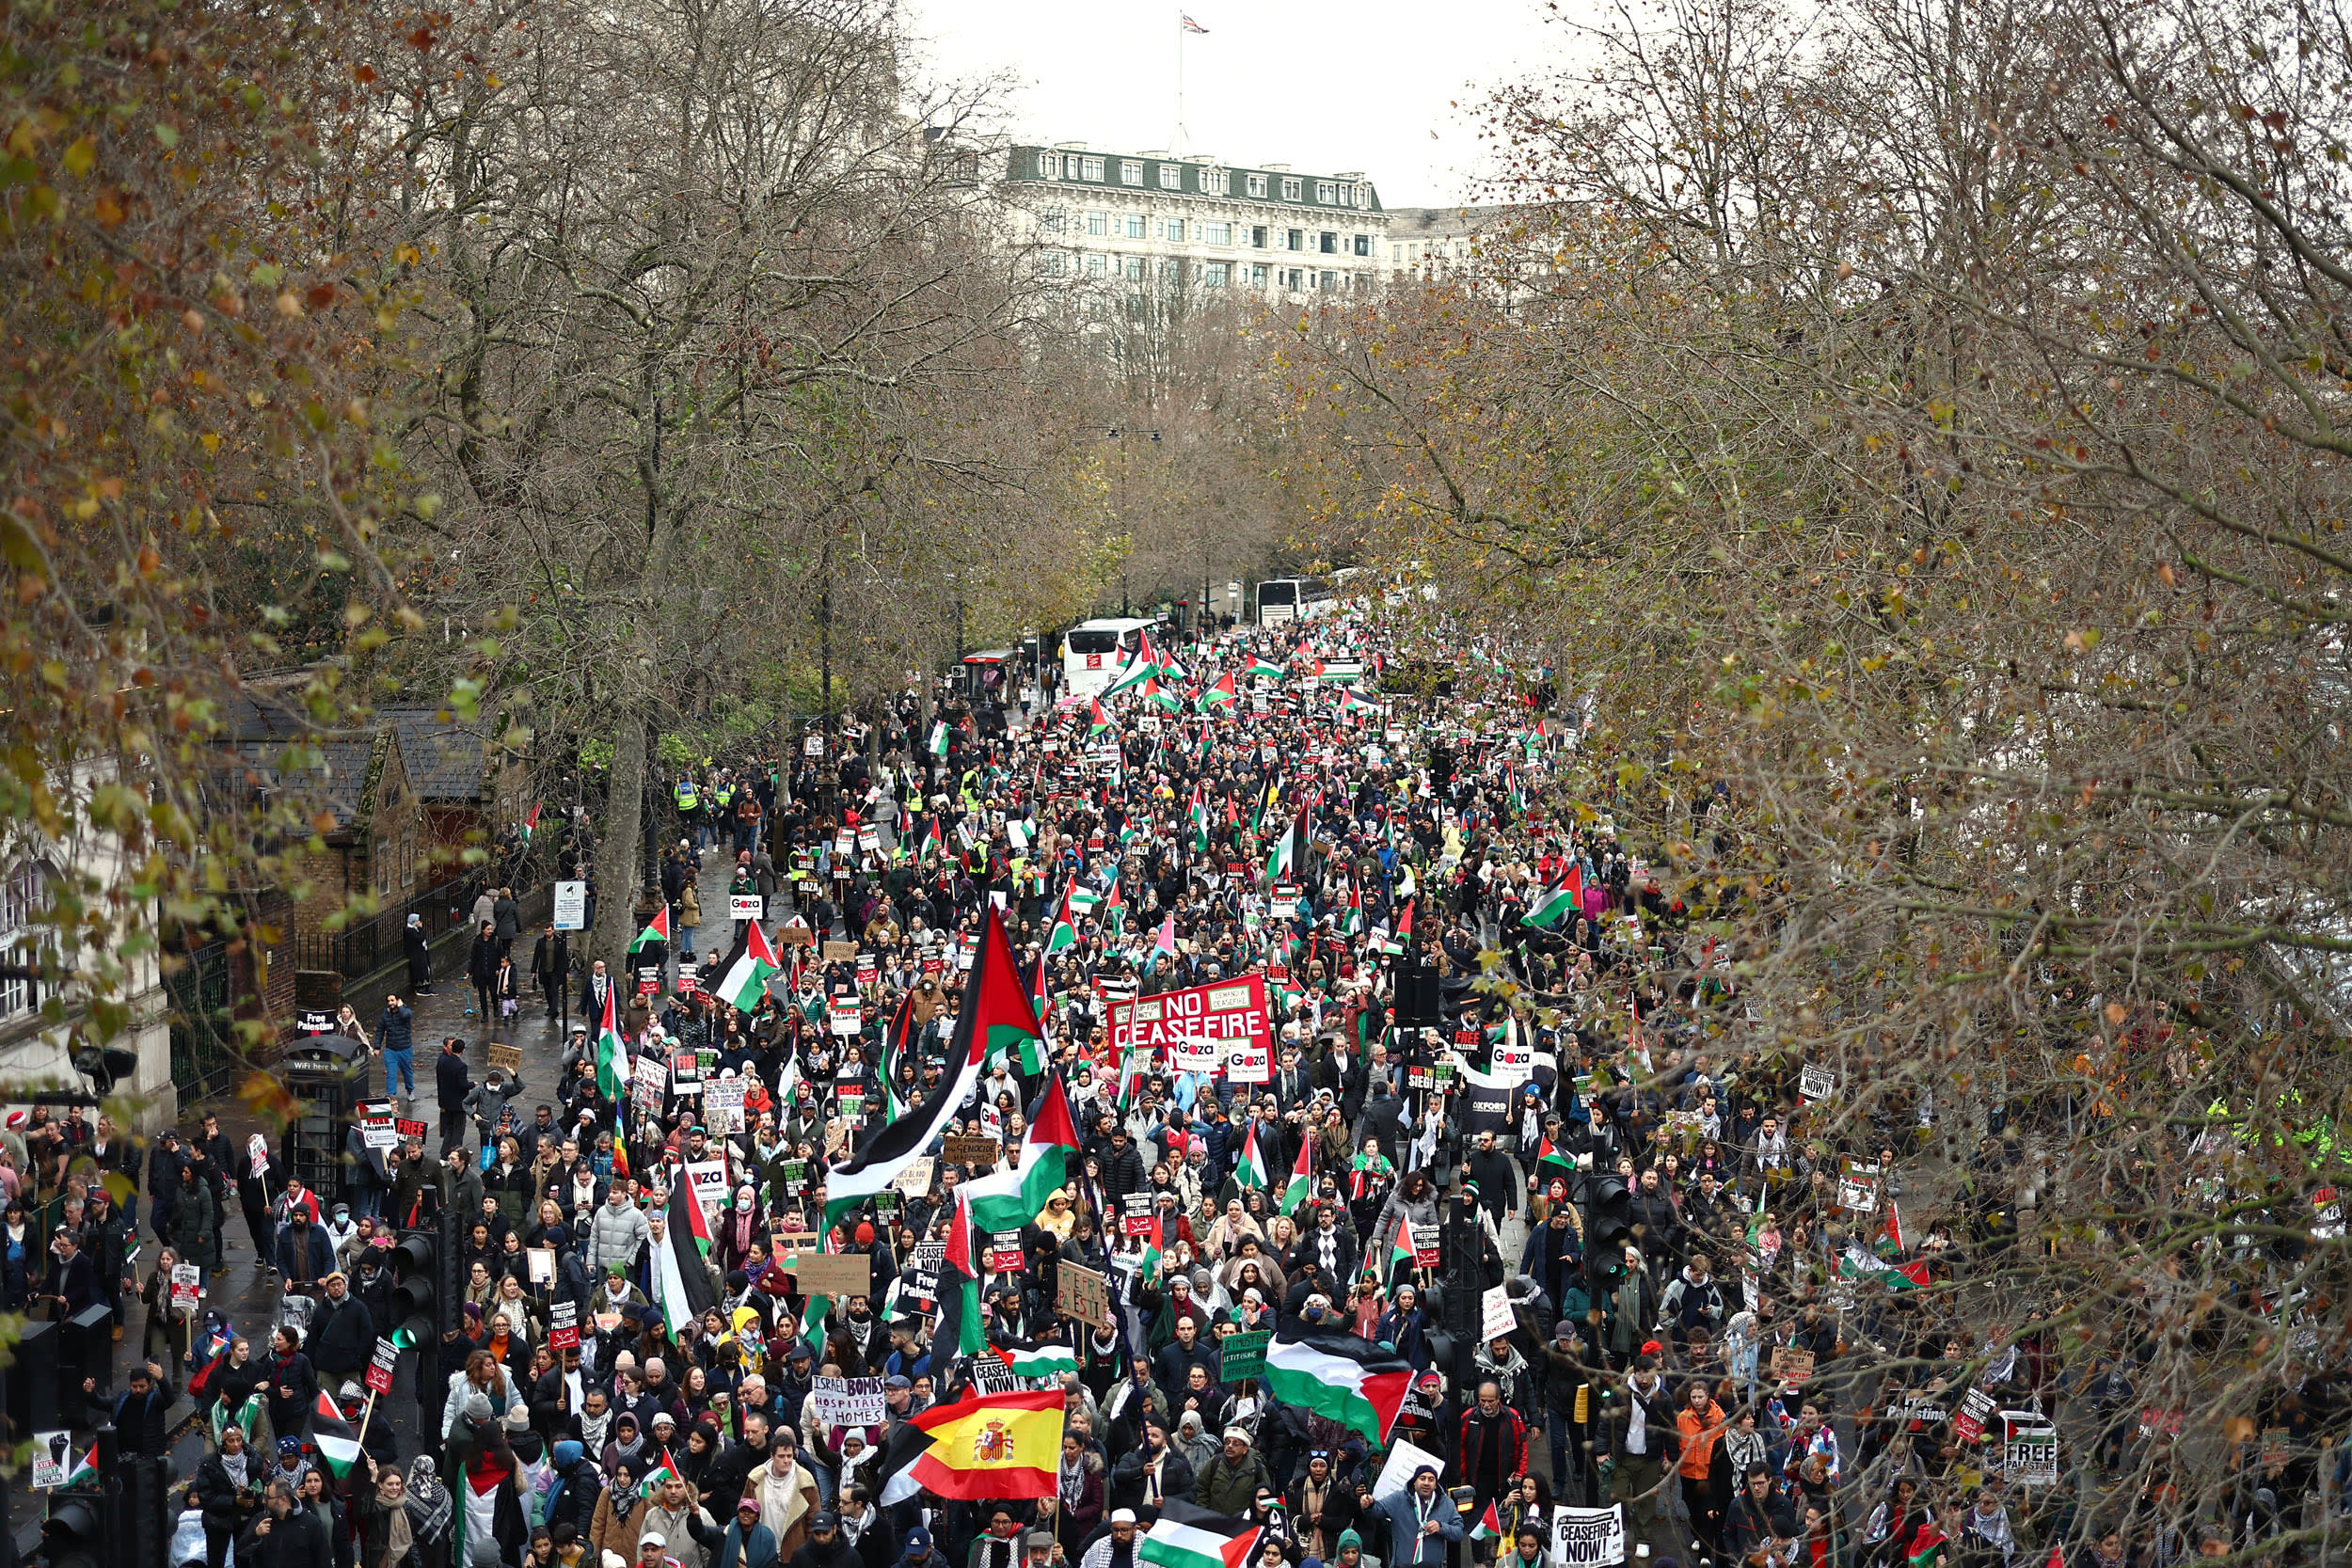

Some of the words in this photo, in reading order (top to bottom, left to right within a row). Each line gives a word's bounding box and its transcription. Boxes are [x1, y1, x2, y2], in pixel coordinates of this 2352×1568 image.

[798, 861, 815, 869] SIEGE
[1227, 863, 1245, 872] FREE
[833, 870, 850, 879] SIEGE
[798, 881, 818, 893] GAZA
[1267, 967, 1289, 977] FREE
[1166, 992, 1201, 1019] NO
[307, 1013, 326, 1022] Free
[297, 1021, 334, 1031] Palestine
[1454, 1031, 1481, 1045] FREE
[1453, 1043, 1478, 1052] PALESTINE
[313, 1062, 329, 1070] here
[1409, 1067, 1422, 1076] END
[1804, 1067, 1834, 1084] CEASEFIRE
[1472, 1101, 1506, 1110] OXFORD
[367, 1117, 389, 1125] FREE
[397, 1118, 423, 1135] FREE
[1125, 1198, 1150, 1208] FREEDOM
[1125, 1209, 1152, 1218] PALESTINE
[993, 1233, 1019, 1242] FREEDOM
[1414, 1231, 1439, 1241] FREEDOM
[993, 1243, 1021, 1252] PALESTINE
[916, 1273, 938, 1289] Free
[552, 1307, 576, 1320] FREEDOM
[551, 1318, 578, 1330] PALESTINE
[376, 1344, 396, 1361] FREEDOM
[371, 1354, 395, 1373] PALESTINE
[814, 1378, 847, 1394] ISRAEL
[847, 1377, 884, 1397] BOMBS
[815, 1397, 884, 1409] HOSPITALS
[1966, 1394, 1991, 1413] FREEDOM
[821, 1410, 830, 1420] &
[835, 1409, 882, 1423] HOMES
[1887, 1404, 1947, 1420] Palestine
[2007, 1444, 2055, 1462] FREE
[2006, 1461, 2055, 1471] PALESTINE
[1561, 1521, 1612, 1541] CEASEFIRE
[1565, 1538, 1607, 1562] NOW!
